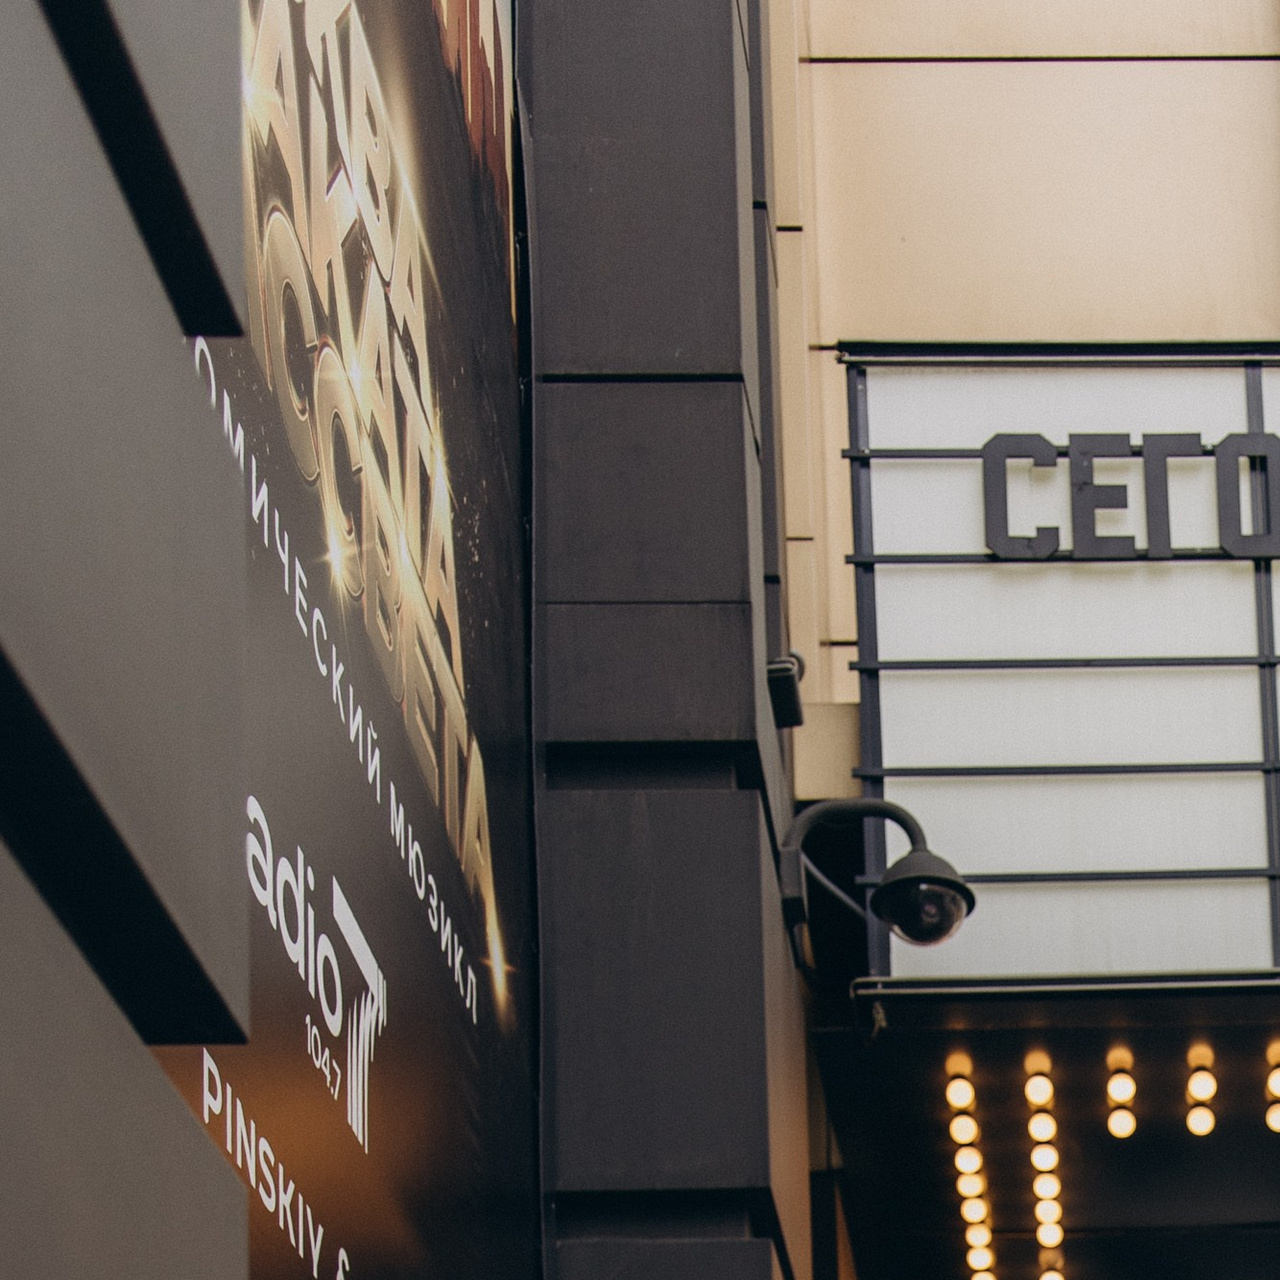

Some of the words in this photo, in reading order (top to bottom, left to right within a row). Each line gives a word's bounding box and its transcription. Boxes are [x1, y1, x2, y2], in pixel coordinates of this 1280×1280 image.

[243, 0, 465, 703] АКАТА
[389, 780, 478, 1026] МЮЗИКЛ
[203, 1047, 324, 1280] PINSKIY
[305, 1013, 342, 1101] 104.7
